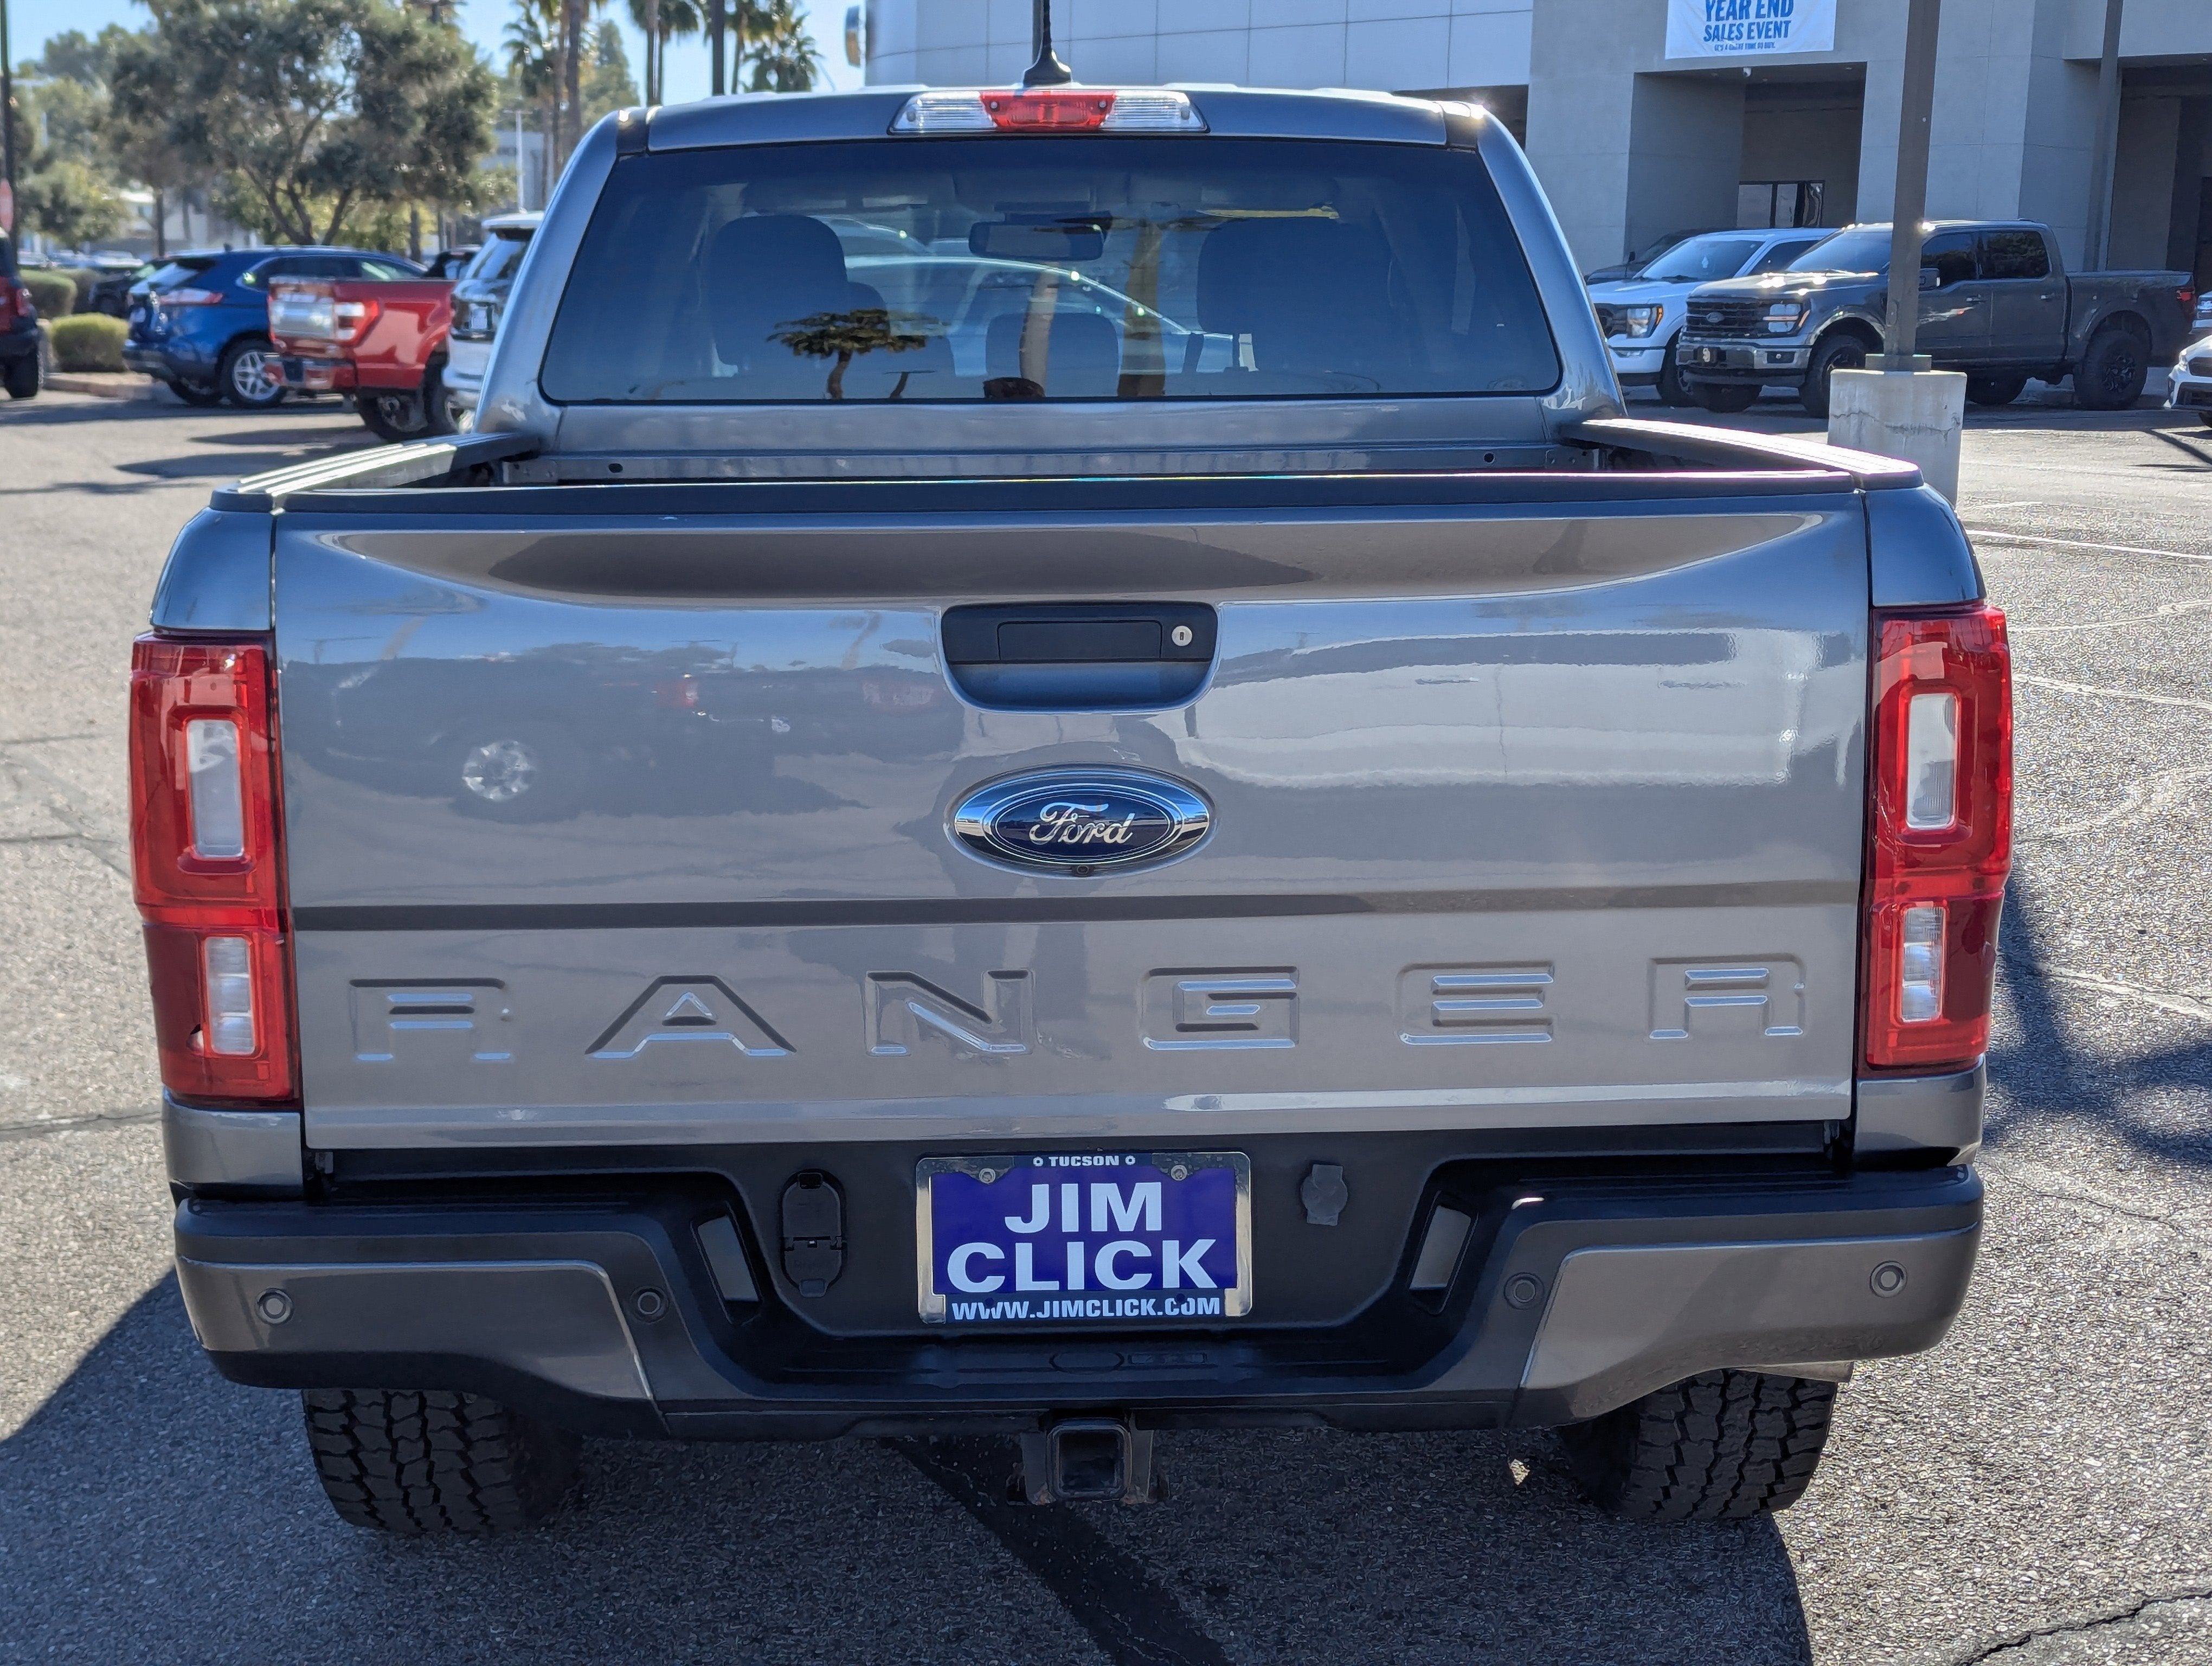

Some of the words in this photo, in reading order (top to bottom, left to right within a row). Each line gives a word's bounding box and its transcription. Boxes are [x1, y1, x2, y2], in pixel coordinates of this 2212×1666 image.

[1706, 0, 1751, 21] YEAR
[1756, 0, 1793, 18] END
[1703, 22, 1744, 42] SALES
[1747, 20, 1792, 40] EVENT
[1029, 802, 1136, 845] Ford
[348, 952, 1805, 1061] RANGER
[1049, 1156, 1120, 1167] TUCSON
[1005, 1182, 1162, 1233] JIM
[947, 1239, 1218, 1293] CLICK
[951, 1297, 1220, 1321] WWW.JIMCLICK.COM
